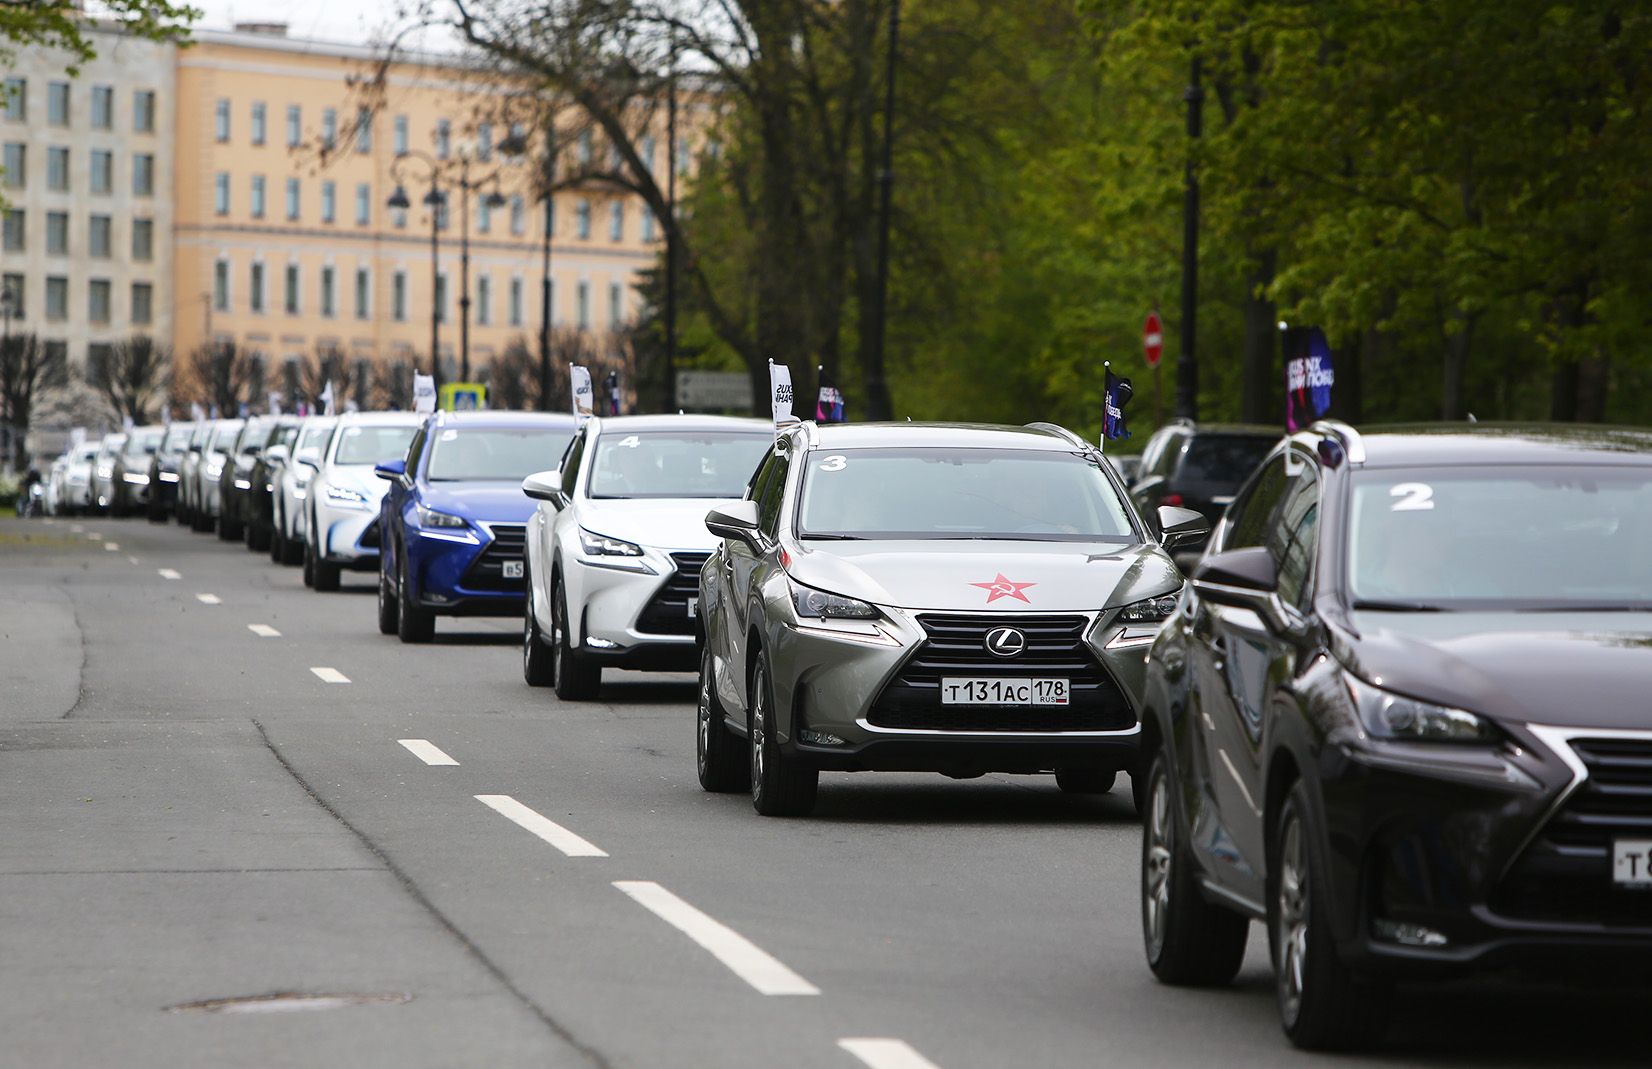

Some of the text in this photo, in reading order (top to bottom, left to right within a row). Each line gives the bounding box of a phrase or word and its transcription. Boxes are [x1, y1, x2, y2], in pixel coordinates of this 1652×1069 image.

[618, 436, 640, 448] 4
[819, 455, 847, 472] 3
[1390, 482, 1434, 511] 2
[949, 681, 1064, 702] Т131АС 178
